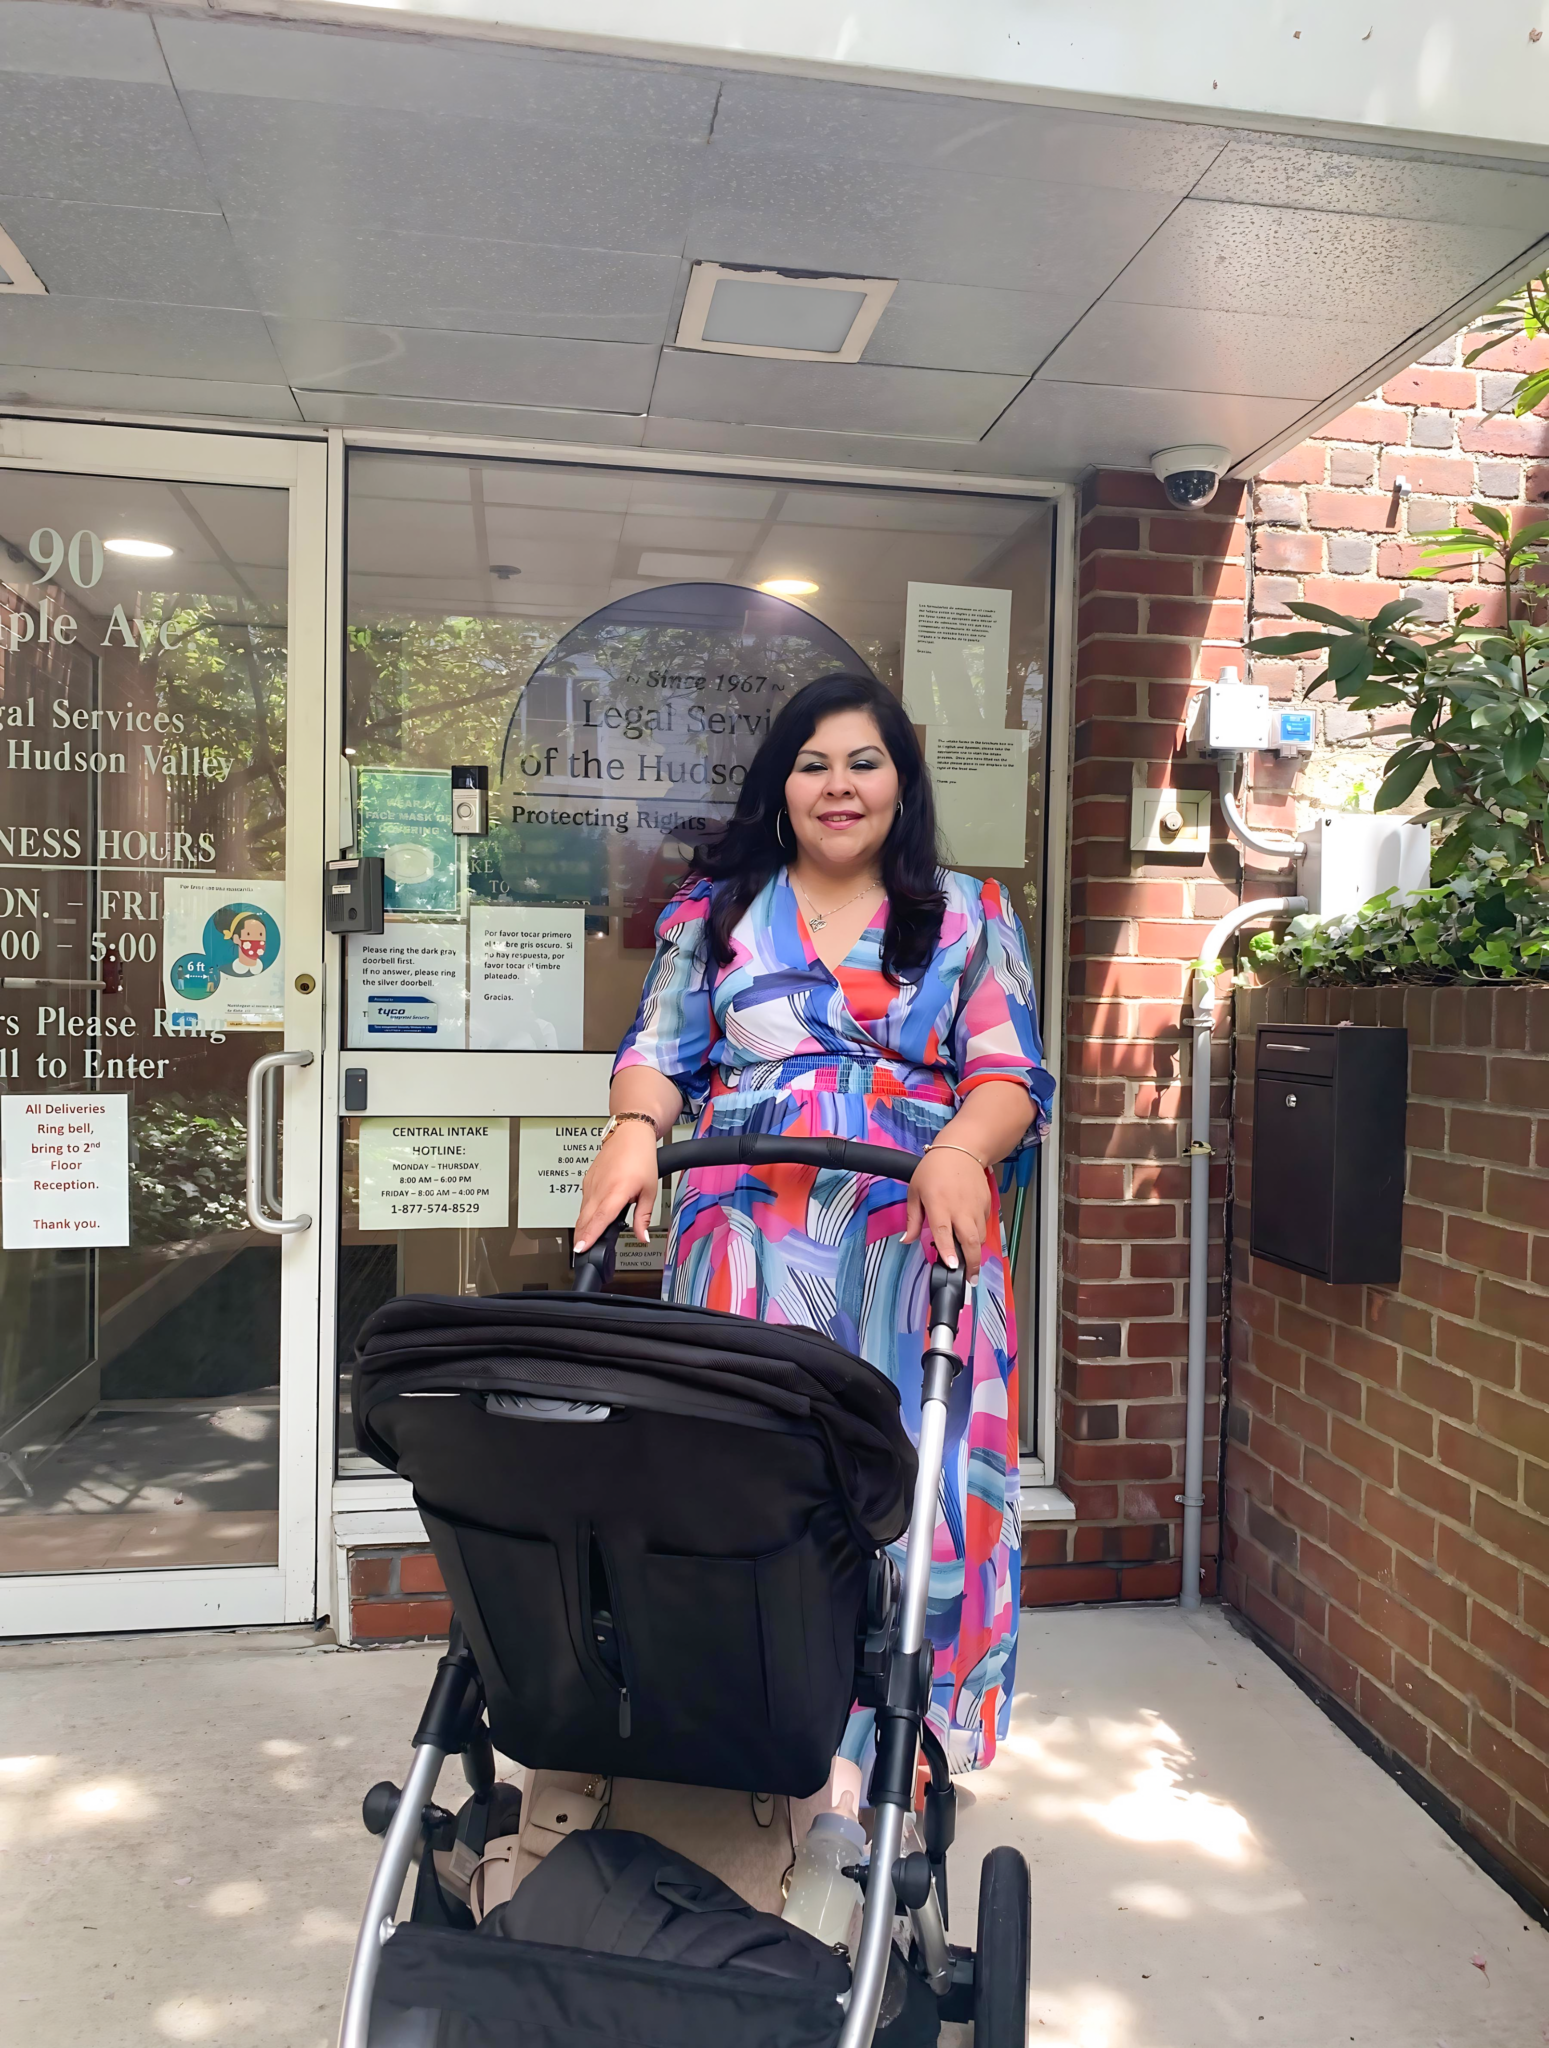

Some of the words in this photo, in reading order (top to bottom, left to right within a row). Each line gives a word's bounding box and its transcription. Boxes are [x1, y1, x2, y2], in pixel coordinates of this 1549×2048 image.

[28, 527, 104, 589] 90
[0, 599, 78, 652] ple
[100, 603, 197, 650] Ave.
[646, 670, 706, 691] Since
[716, 674, 767, 693] 1967
[52, 698, 185, 734] Services
[582, 699, 673, 740] Legal
[686, 705, 771, 736] Servi
[7, 739, 127, 773] Hudson
[142, 744, 235, 783] Valley
[520, 747, 558, 777] of
[569, 749, 625, 781] the
[637, 753, 748, 786] Hudso
[366, 811, 396, 820] FACE
[400, 811, 432, 822] MASK
[512, 805, 628, 833] Protecting
[637, 811, 706, 834] Rights
[98, 829, 216, 863] HOURS
[484, 929, 498, 937] Por
[541, 931, 572, 939] primero
[90, 932, 157, 963] 5:00
[362, 946, 388, 954] Please
[389, 947, 405, 955] ring
[187, 961, 195, 972] 6
[196, 961, 206, 972] ft
[397, 957, 415, 965] first.
[377, 1007, 406, 1017] tyco
[36, 1006, 137, 1037] Please
[153, 1008, 227, 1045] Ring
[36, 1052, 67, 1079] to
[83, 1049, 170, 1079] Enter
[25, 1104, 42, 1114] All
[45, 1104, 106, 1114] Deliveries
[37, 1123, 65, 1136] Ring
[68, 1123, 94, 1135] bell,
[392, 1127, 445, 1137] CENTRAL
[447, 1126, 489, 1137] INTAKE
[555, 1127, 588, 1137] LINEA
[31, 1143, 63, 1156] bring
[66, 1145, 80, 1153] to
[83, 1141, 101, 1153] 2nd
[412, 1146, 466, 1156] HOTLINE:
[50, 1160, 83, 1170] Floor
[557, 1156, 574, 1164] 8:00
[575, 1156, 589, 1164] AM
[392, 1163, 429, 1171] MONDAY
[437, 1162, 479, 1170] THURSDAY
[538, 1169, 569, 1177] VIERNES
[33, 1179, 100, 1192] Reception.
[399, 1176, 417, 1184] 8:00
[440, 1175, 457, 1183] 6:00
[458, 1175, 472, 1183] PM
[458, 1188, 475, 1196] 4:00
[476, 1188, 490, 1196] PM
[391, 1202, 480, 1214] 1-877-574-8529
[33, 1219, 71, 1230] Thank
[73, 1220, 101, 1231] you.
